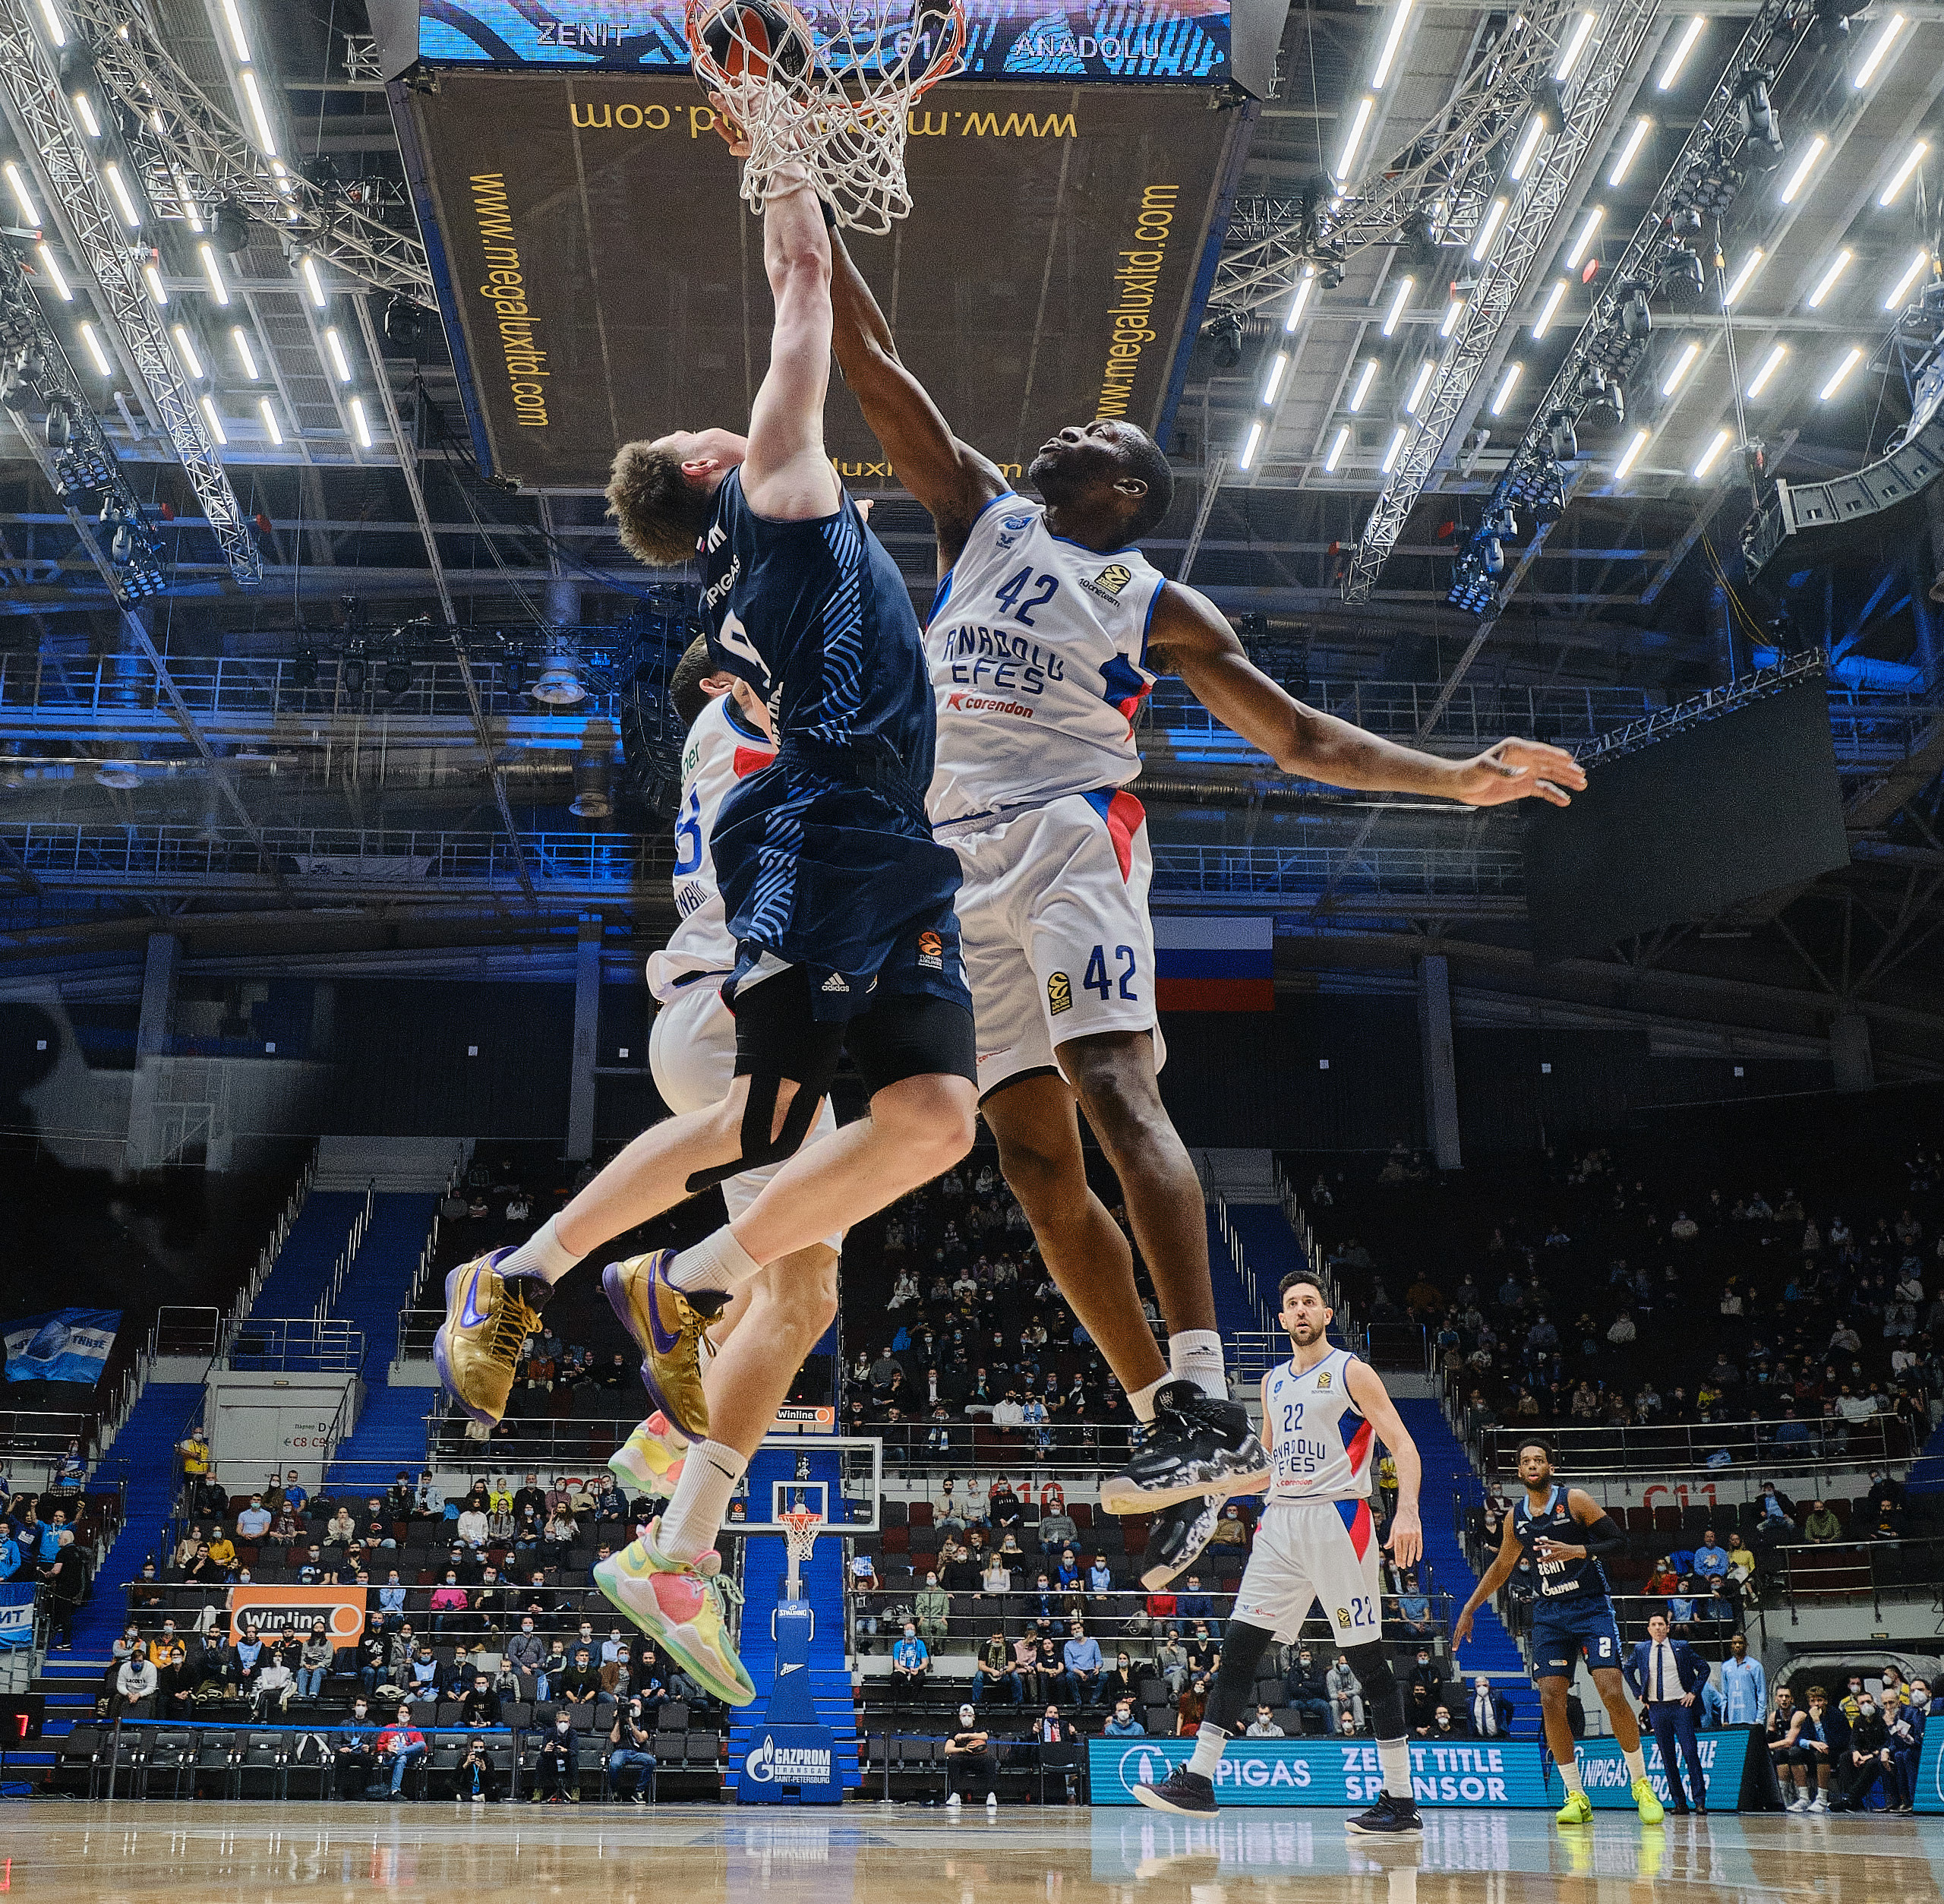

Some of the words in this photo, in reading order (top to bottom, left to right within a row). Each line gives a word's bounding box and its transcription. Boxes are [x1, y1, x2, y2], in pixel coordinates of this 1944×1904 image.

[537, 21, 630, 46] ZENIT
[894, 31, 930, 59] 61
[1015, 35, 1160, 60] ANADOLU
[469, 172, 551, 427] www.megaluxltd.com
[1096, 185, 1179, 420] ww.megaluxltd.com
[995, 566, 1059, 627] 42
[942, 625, 1064, 682] ANADOLU
[951, 658, 1044, 695] EFES
[965, 694, 1034, 718] corendon
[1083, 944, 1138, 1002] 42
[821, 984, 850, 992] adidas
[318, 1422, 327, 1432] D
[778, 1410, 814, 1419] Winline
[1283, 1403, 1304, 1433] 22
[293, 1437, 308, 1448] C8
[1352, 1596, 1375, 1627] 22
[15, 1713, 29, 1737] 7
[775, 1748, 831, 1766] GAZPROM
[1341, 1747, 1427, 1773] ZET
[1432, 1748, 1504, 1773] TITLE
[1583, 1758, 1628, 1788] NIPIGAS
[1345, 1776, 1509, 1802] SPNSOR
